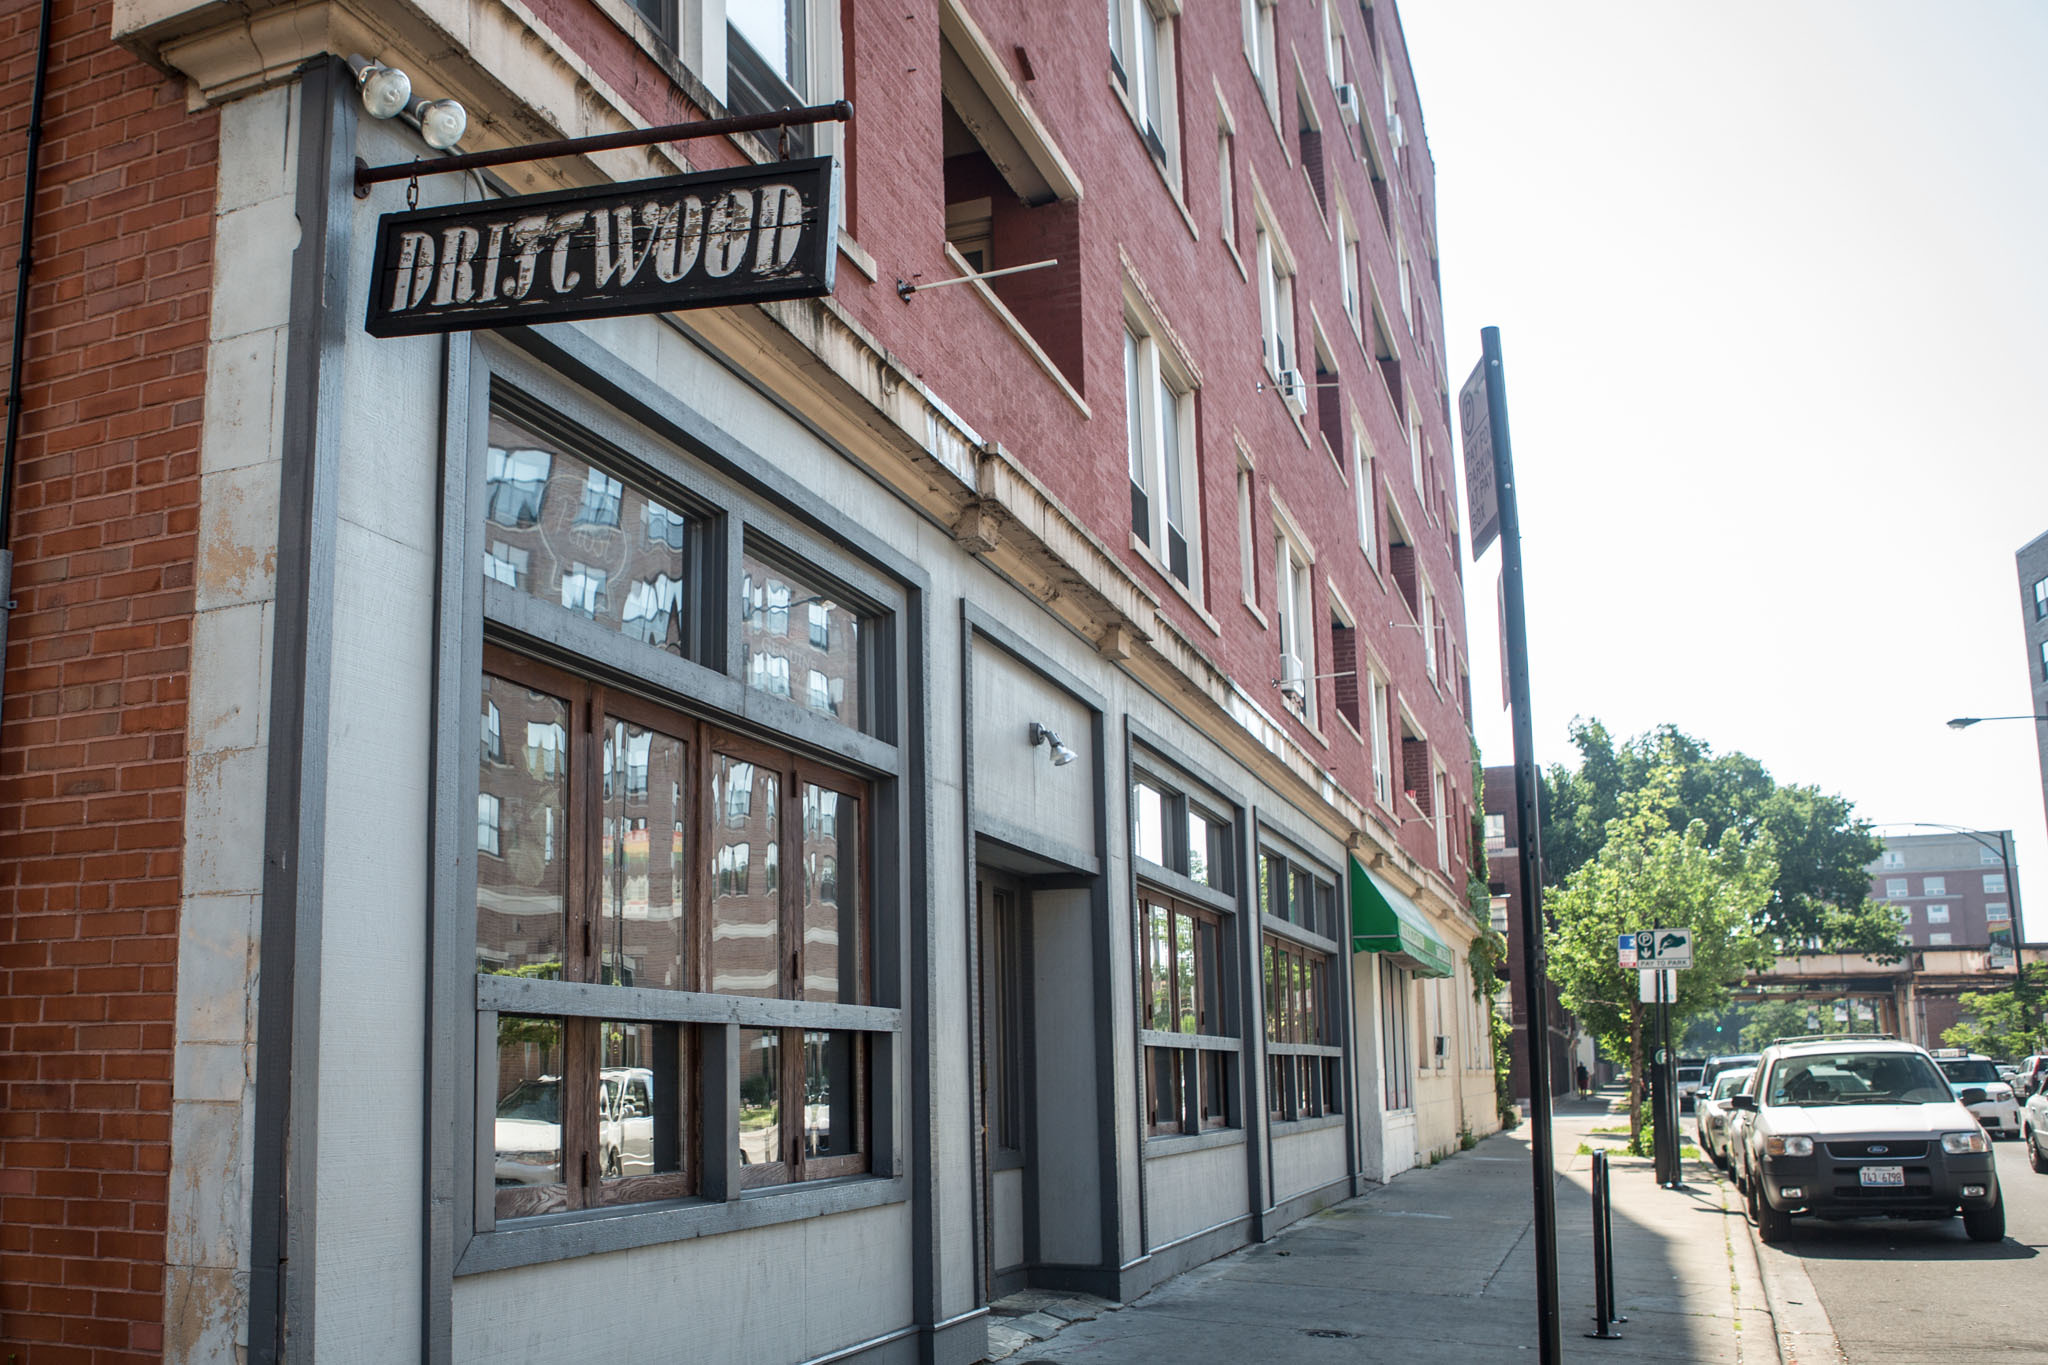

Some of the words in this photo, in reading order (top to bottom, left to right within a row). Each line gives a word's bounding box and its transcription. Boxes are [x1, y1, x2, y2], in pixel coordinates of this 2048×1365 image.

[388, 184, 802, 312] DRIFTWOOD
[1465, 438, 1479, 470] PAY
[1467, 447, 1493, 492] PARKIN
[1480, 467, 1493, 498] PAY
[1471, 502, 1486, 532] BOX
